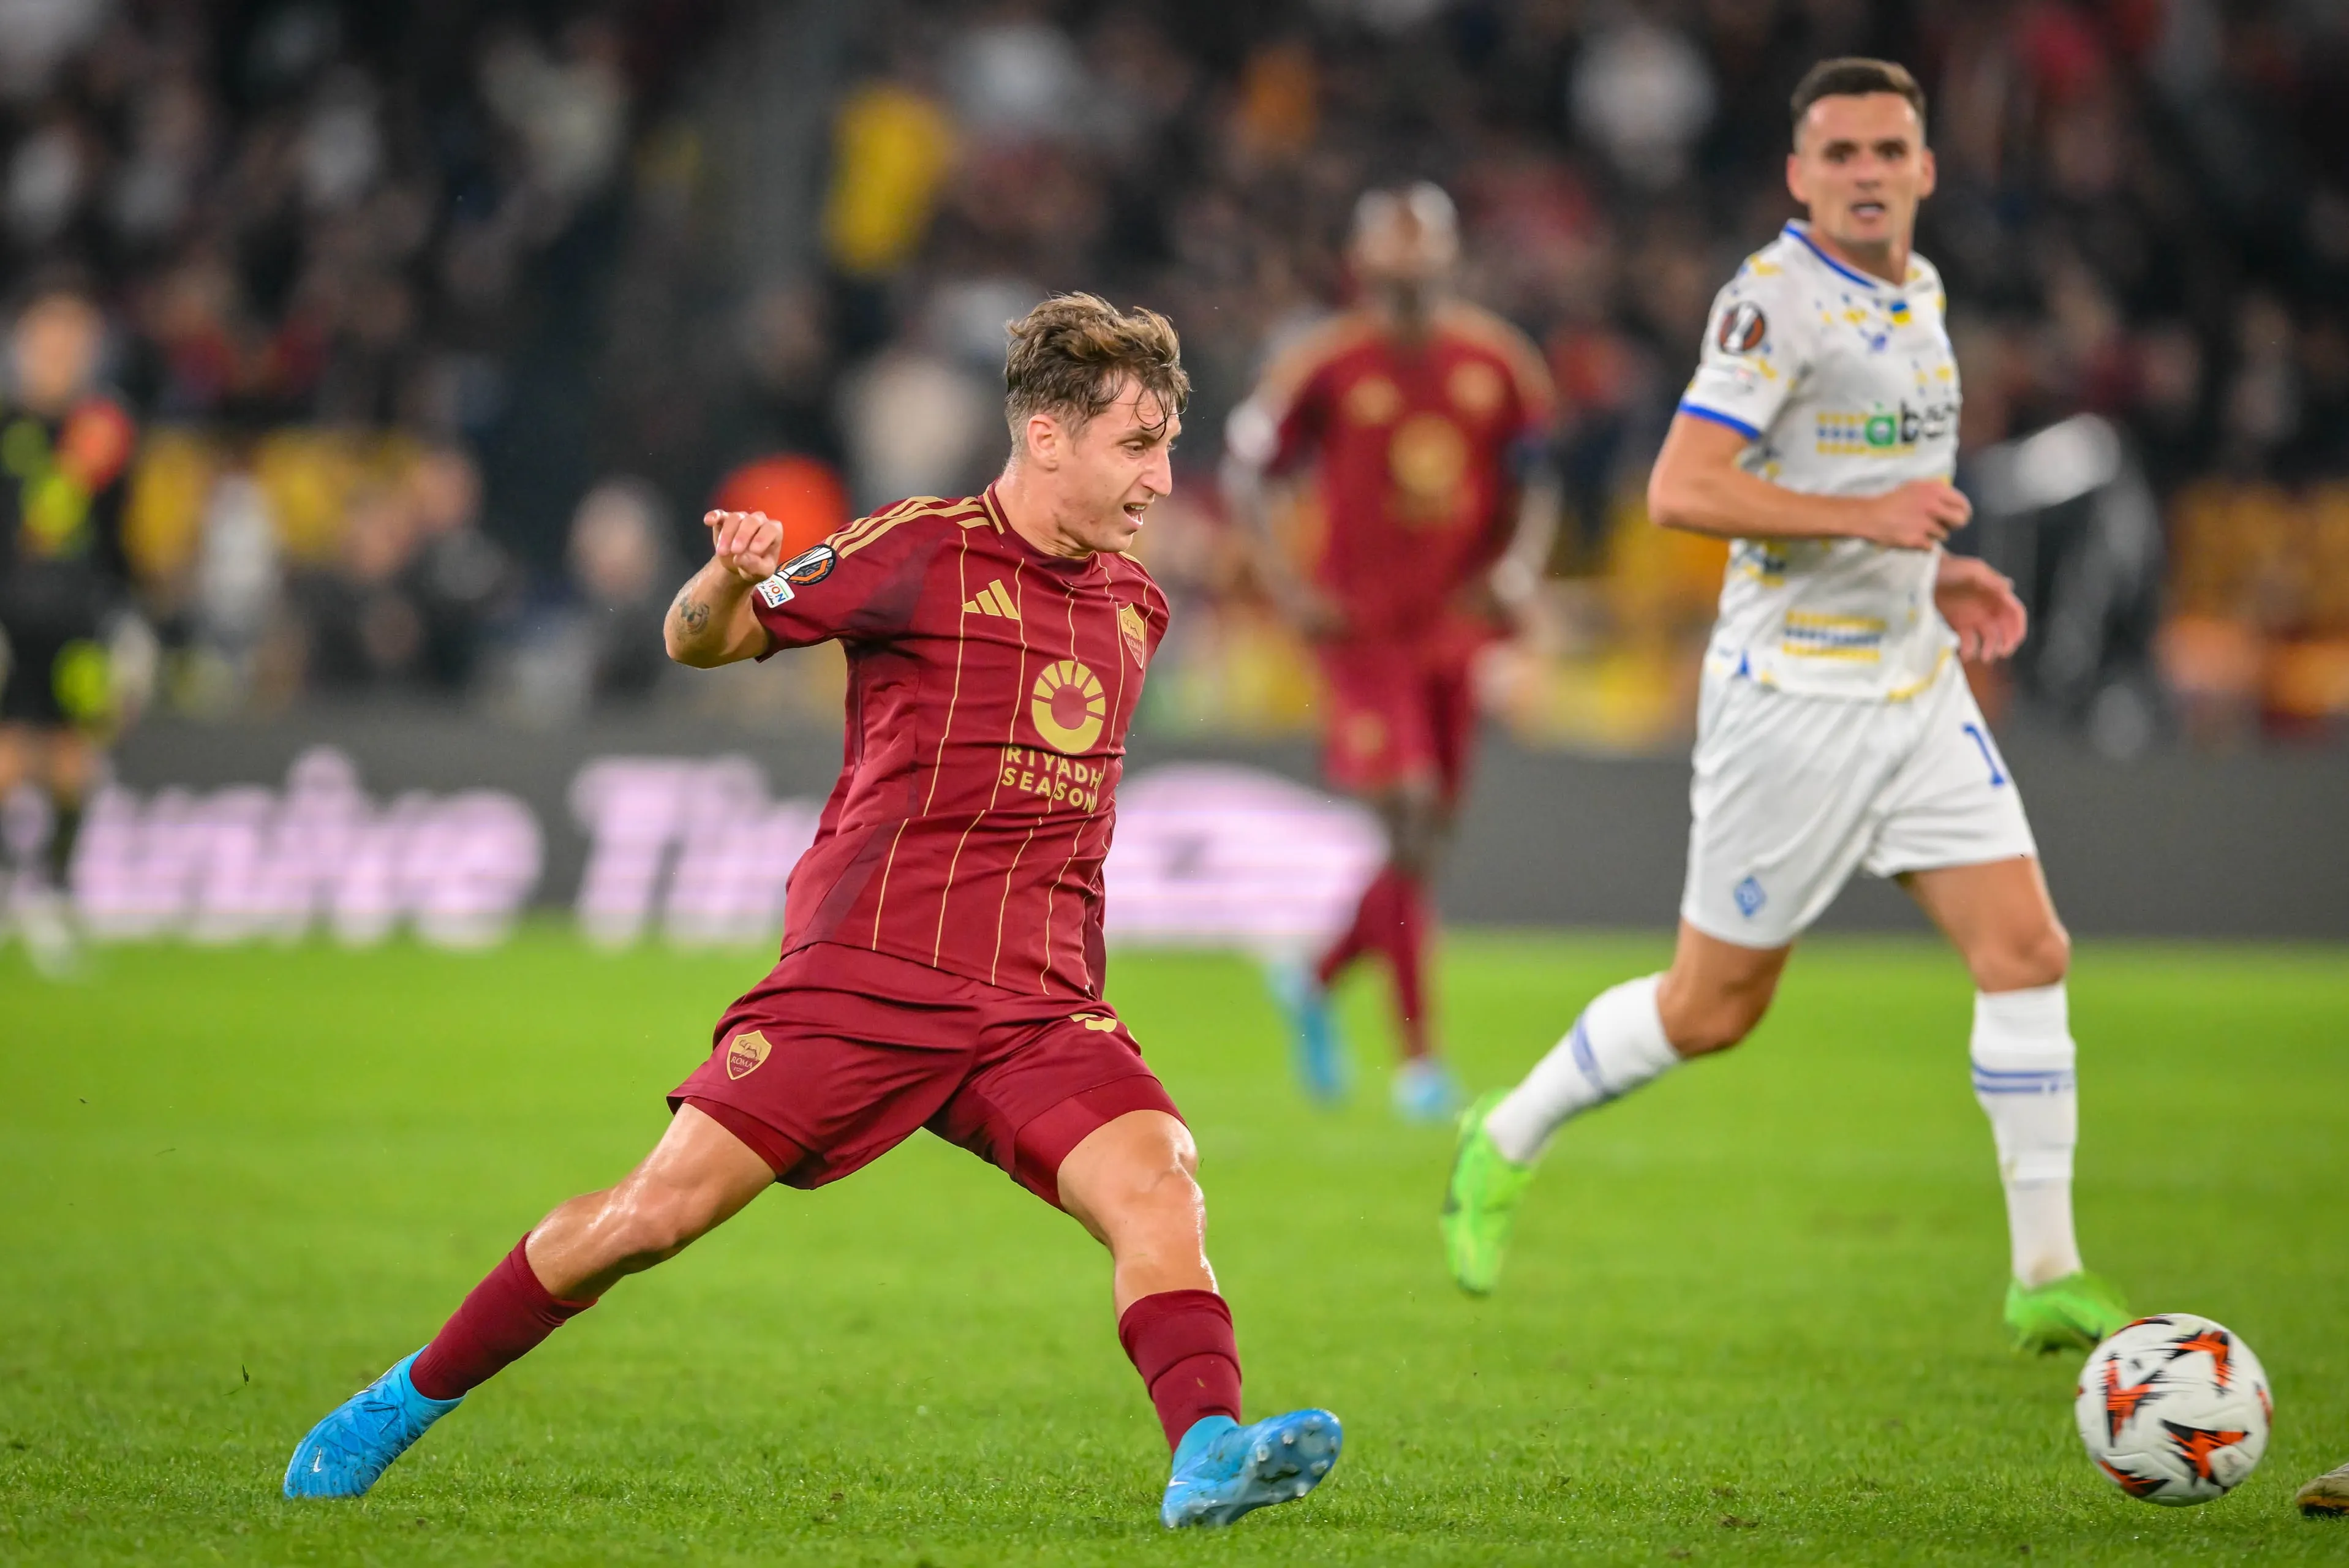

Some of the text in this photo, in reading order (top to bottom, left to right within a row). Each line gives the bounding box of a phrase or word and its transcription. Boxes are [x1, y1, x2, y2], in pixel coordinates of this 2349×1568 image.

[1006, 746, 1103, 790] RIYADH
[1001, 767, 1096, 814] SEASON
[731, 1056, 753, 1069] ROMA
